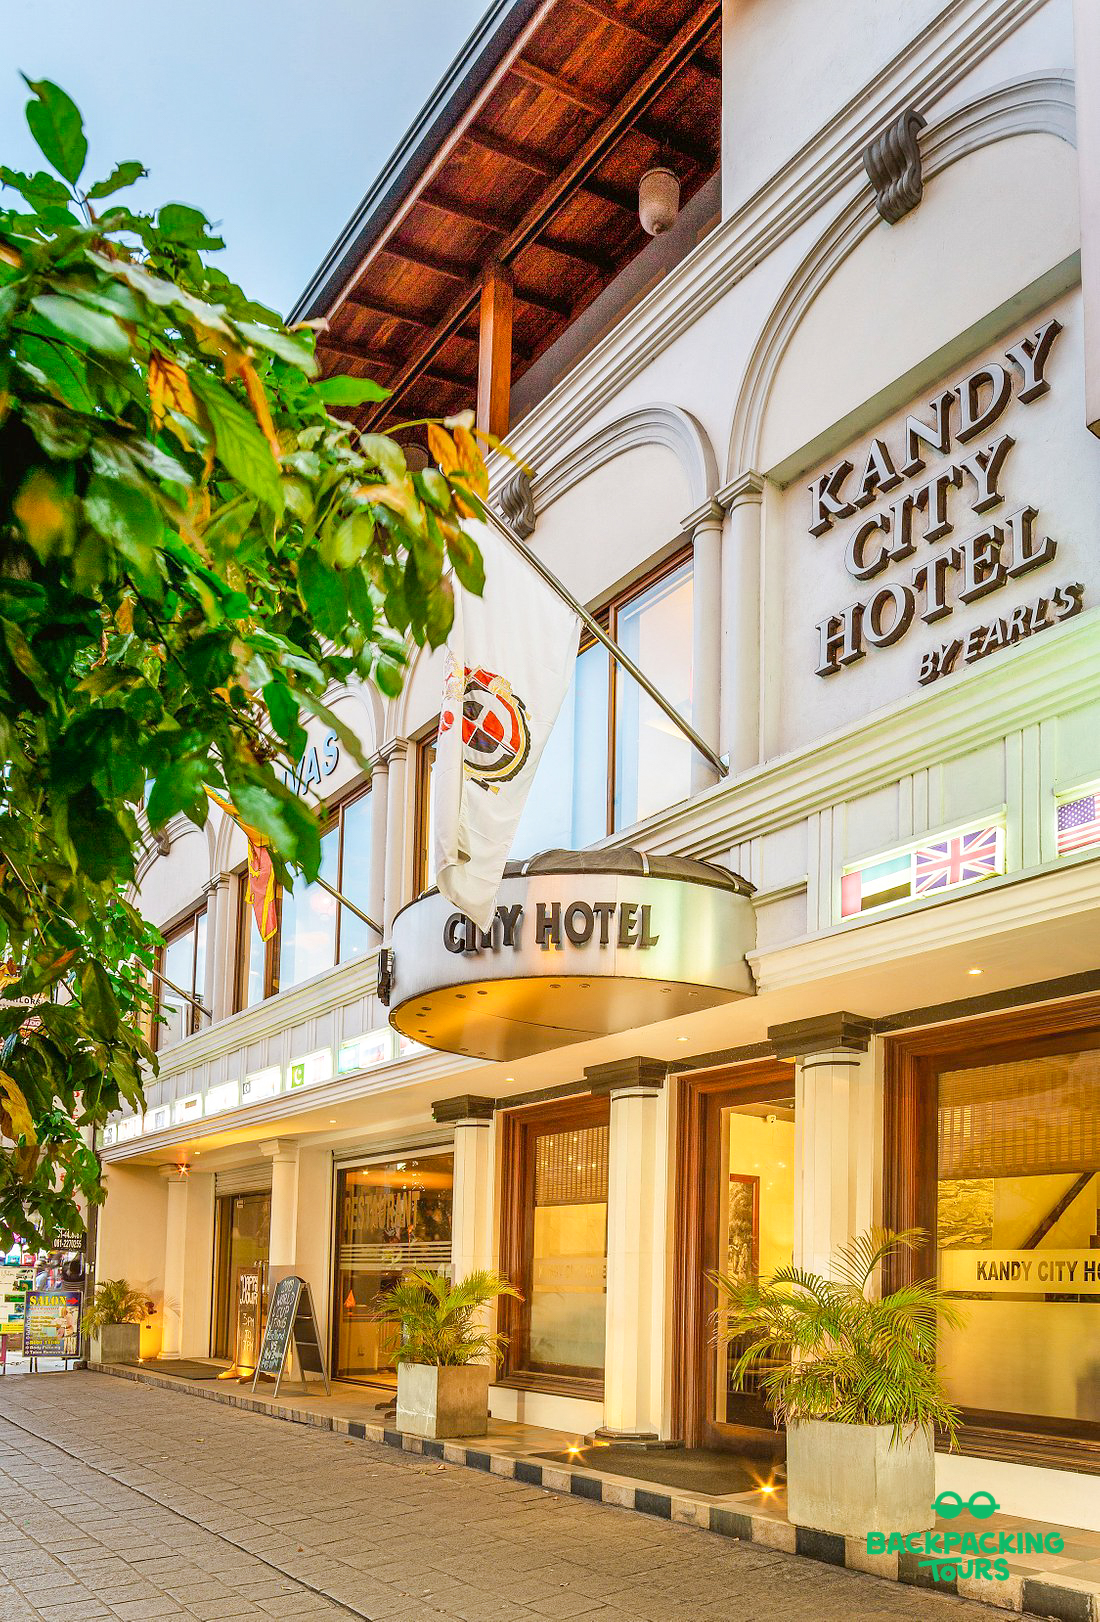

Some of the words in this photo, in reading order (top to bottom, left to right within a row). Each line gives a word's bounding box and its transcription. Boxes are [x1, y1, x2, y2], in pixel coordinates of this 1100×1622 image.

[807, 319, 1064, 538] KANDY
[844, 434, 1017, 581] CITY
[813, 505, 1057, 678] HOTEL
[917, 639, 963, 686] BY
[964, 582, 1085, 664] EARL'S
[535, 901, 659, 946] HOTEL
[29, 1295, 67, 1307] SALON
[976, 1261, 1032, 1281] KANDY
[1037, 1260, 1078, 1282] CITY
